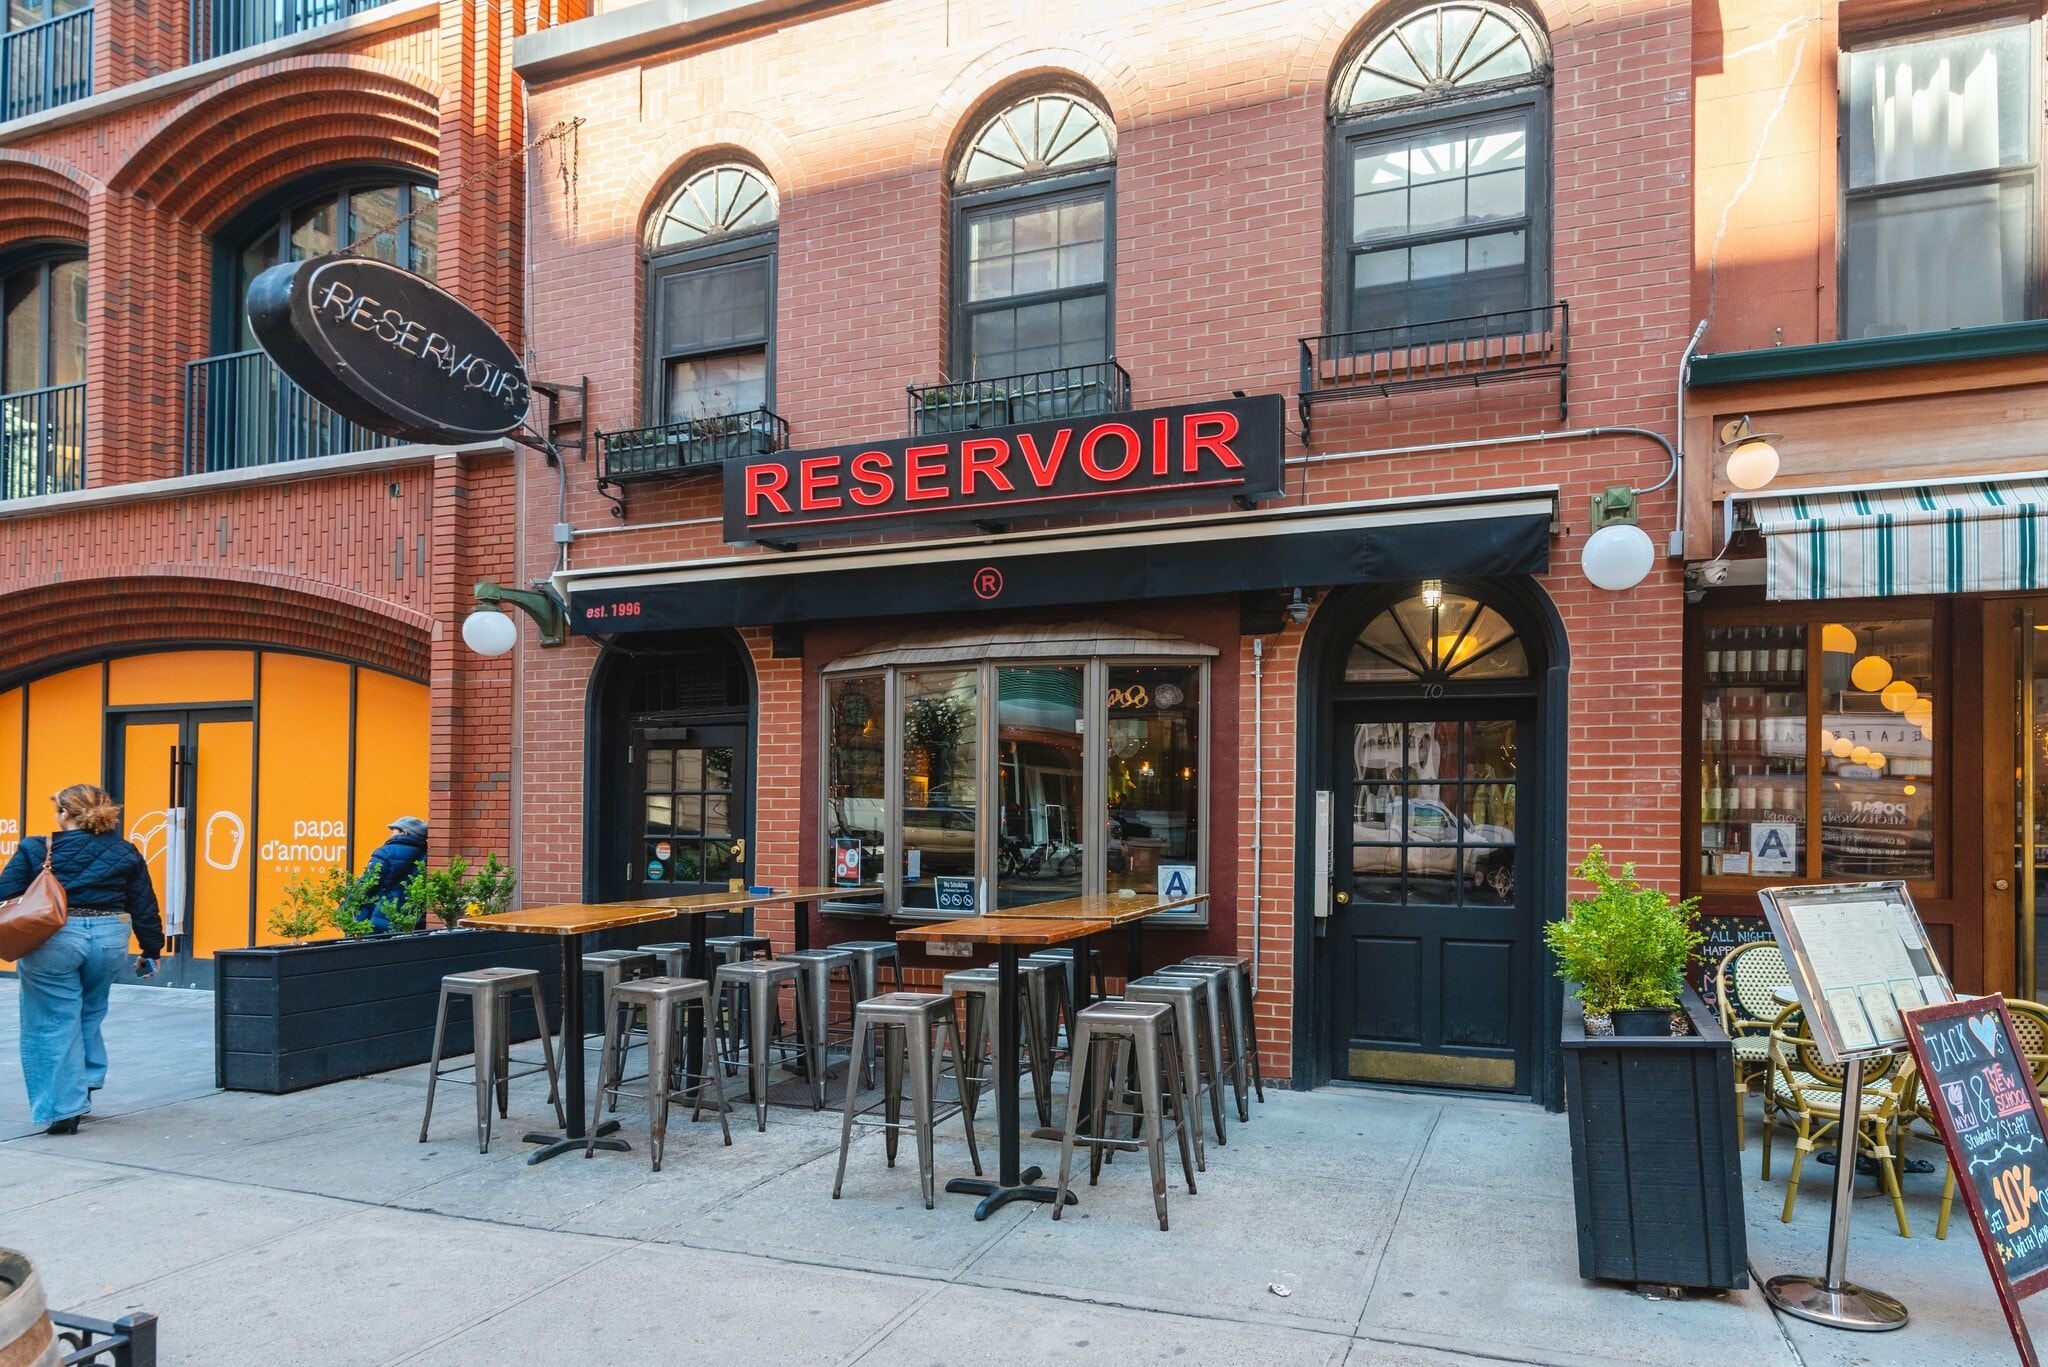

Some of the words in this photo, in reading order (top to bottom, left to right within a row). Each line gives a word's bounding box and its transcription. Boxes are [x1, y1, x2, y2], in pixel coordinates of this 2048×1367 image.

[323, 281, 520, 405] RESERVOIR
[744, 410, 1245, 516] RESERVOIR
[586, 605, 608, 618] est.
[611, 602, 641, 617] 1996
[1421, 684, 1444, 699] 70
[293, 818, 346, 840] papa
[261, 839, 346, 861] d'amour
[1757, 829, 1788, 857] A
[275, 865, 301, 873] NEW
[1165, 871, 1188, 895] A
[1710, 931, 1734, 942] ALL
[1738, 931, 1774, 942] NIGHT
[1703, 945, 1736, 956] HAPP
[1923, 1023, 1977, 1072] JACK
[1981, 1062, 2004, 1079] THE
[1989, 1073, 2015, 1096] NEW
[1994, 1088, 2030, 1111] SCHOOL
[1955, 1112, 1976, 1130] NYU
[1992, 1164, 2039, 1235] 10%
